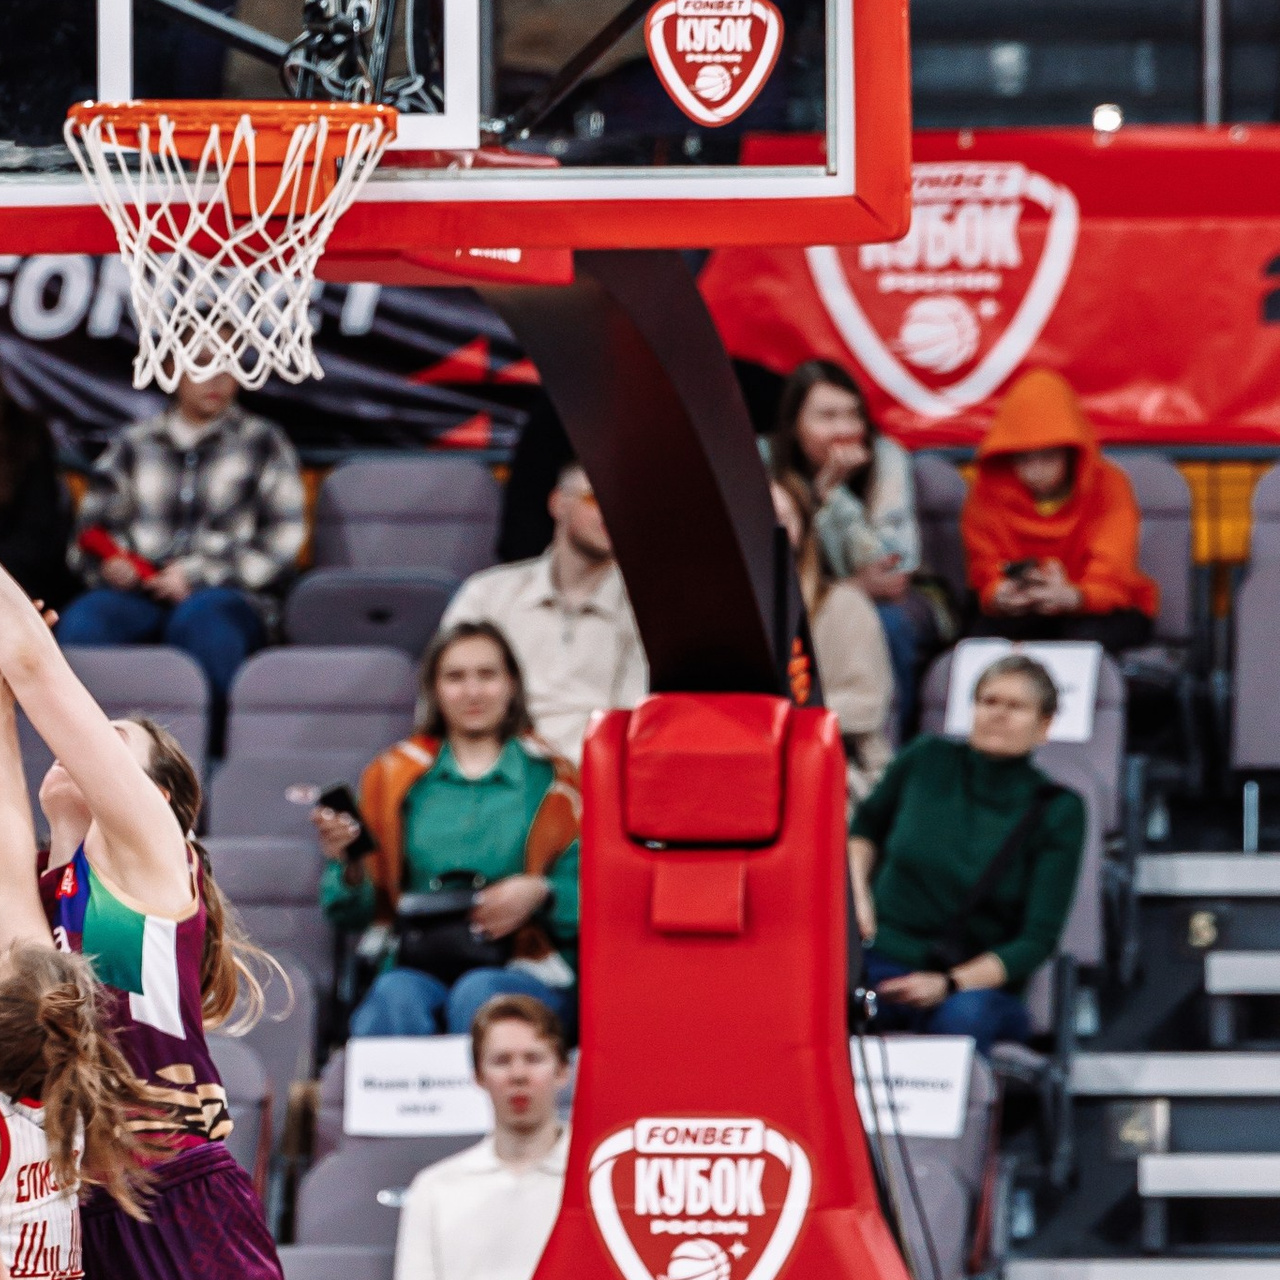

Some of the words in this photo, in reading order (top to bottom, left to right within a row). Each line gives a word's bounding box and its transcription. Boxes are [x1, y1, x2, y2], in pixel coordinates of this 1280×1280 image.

[683, 0, 745, 11] FONBET
[676, 17, 753, 52] КУБОК
[646, 1126, 752, 1145] FONBET
[634, 1157, 766, 1216] КУБОК
